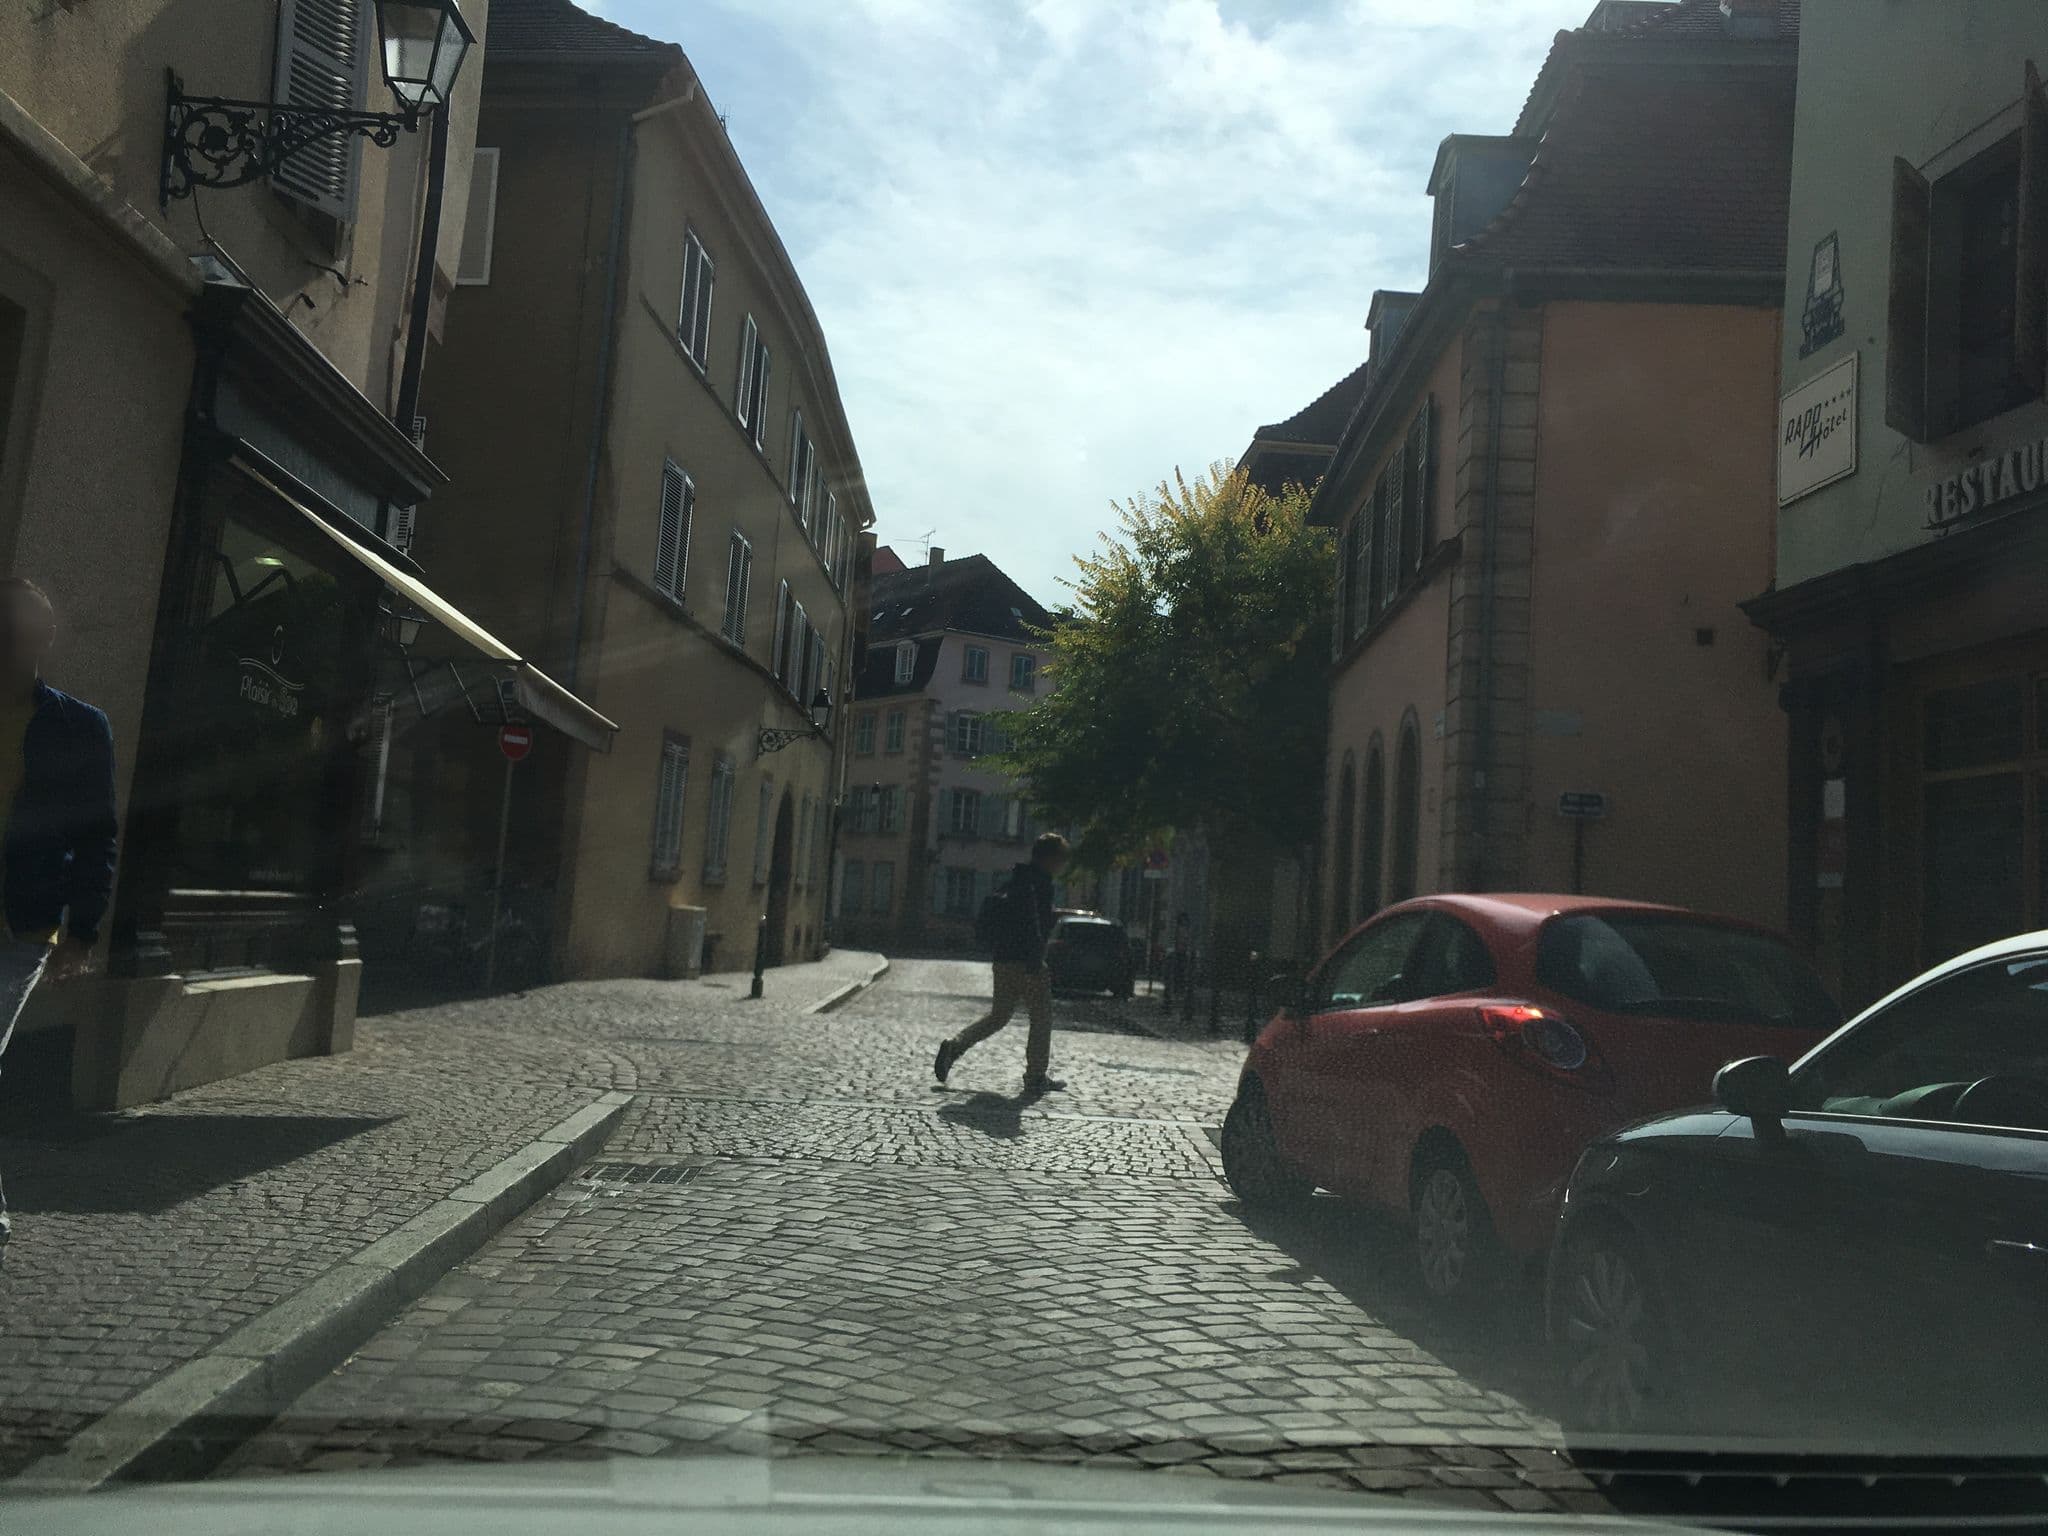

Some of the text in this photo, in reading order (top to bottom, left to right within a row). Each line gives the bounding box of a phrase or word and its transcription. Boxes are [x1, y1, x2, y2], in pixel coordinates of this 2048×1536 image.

[1785, 402, 1822, 449] RAPP
[1799, 408, 1847, 459] Hôtel
[240, 675, 272, 704] Plaisir
